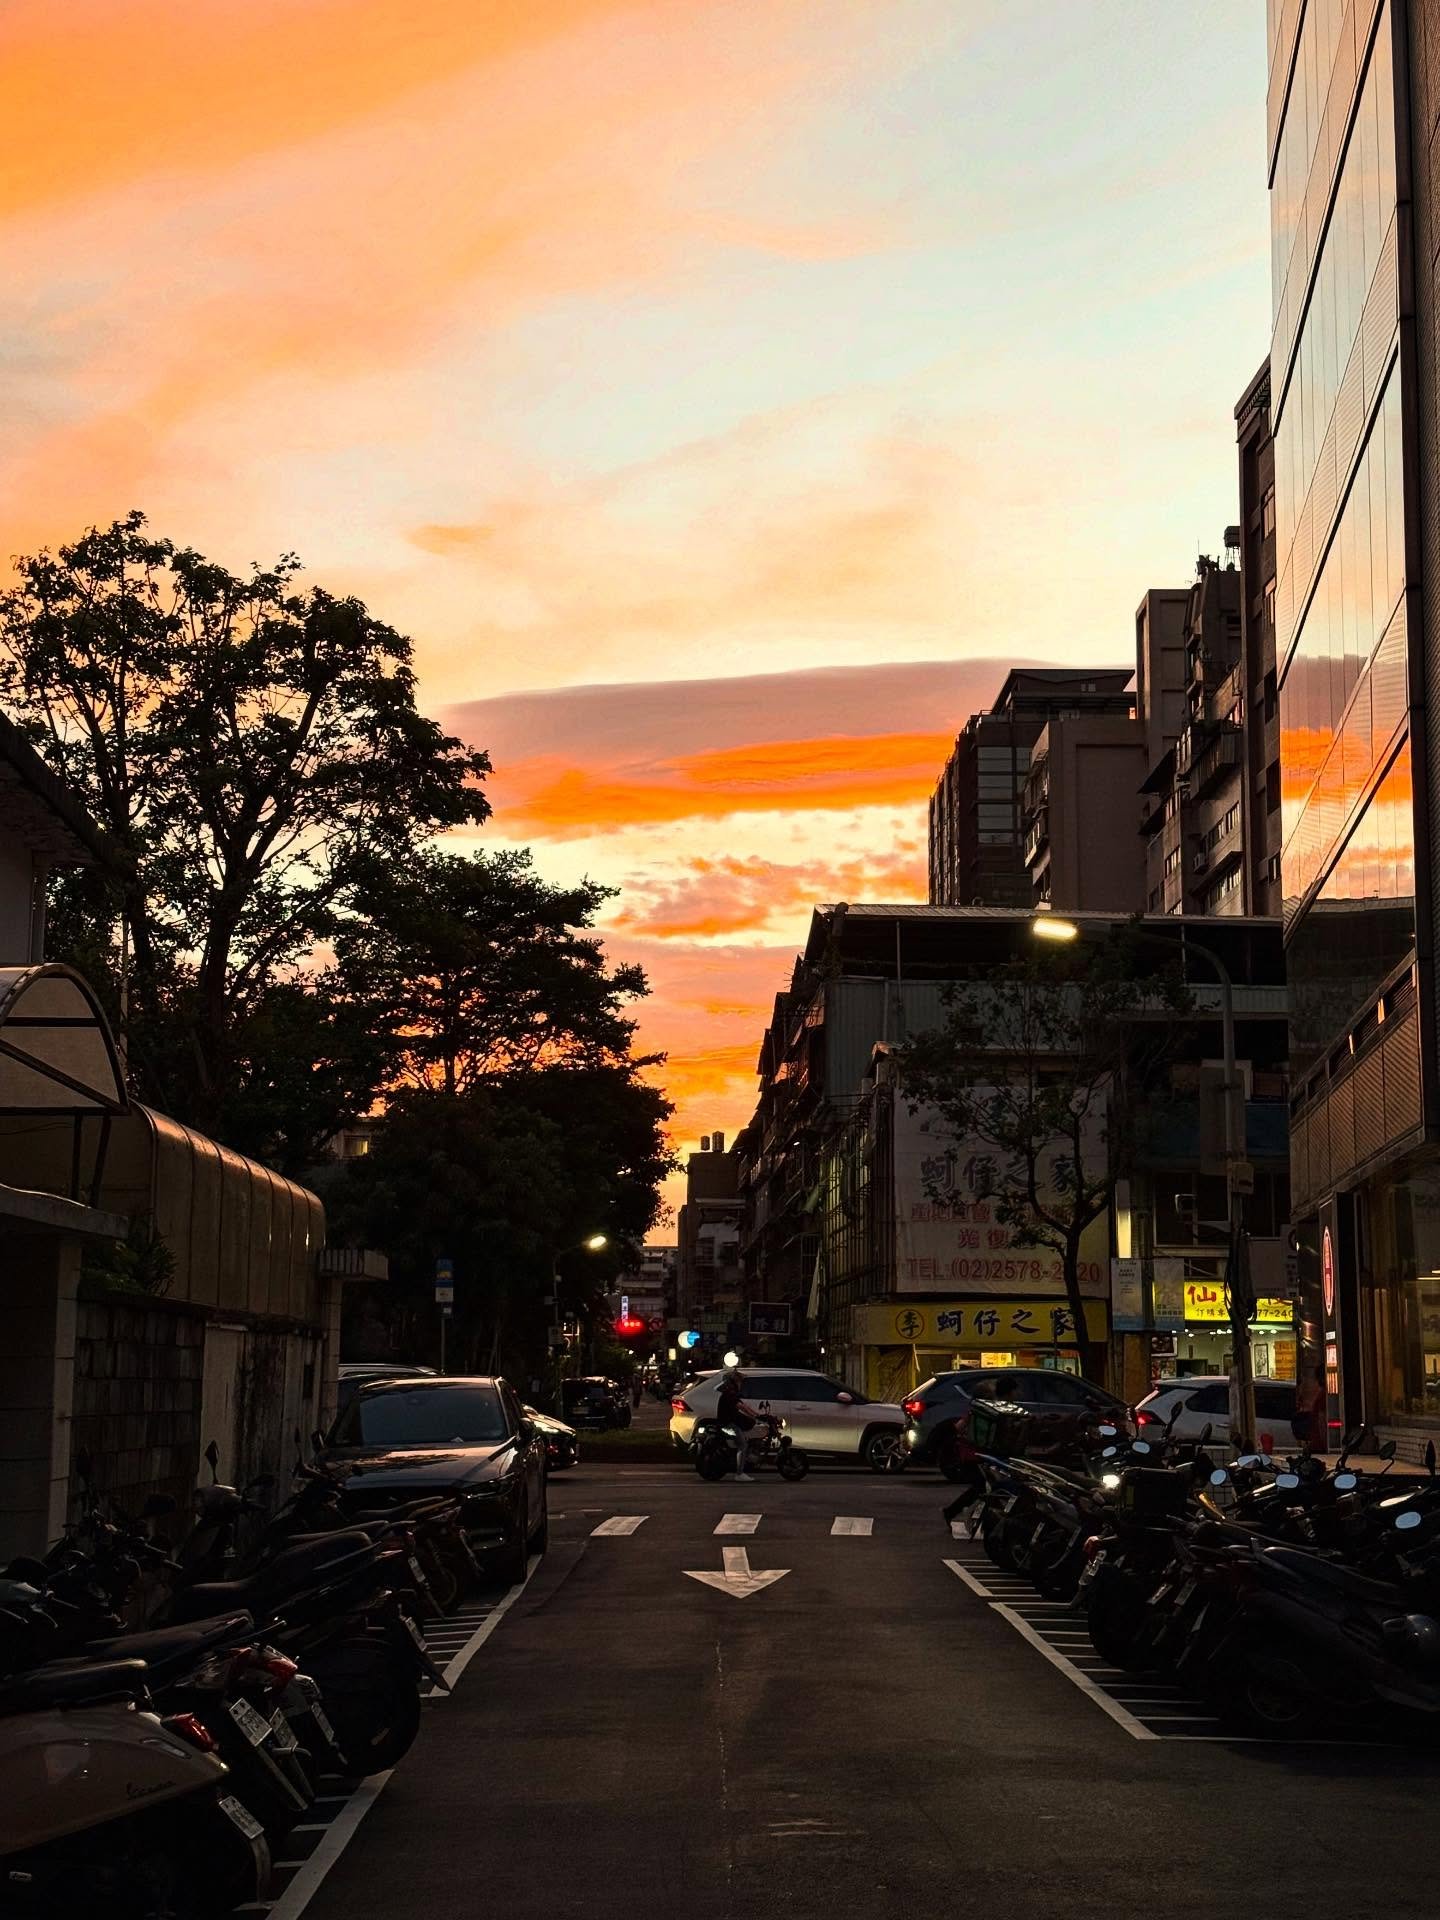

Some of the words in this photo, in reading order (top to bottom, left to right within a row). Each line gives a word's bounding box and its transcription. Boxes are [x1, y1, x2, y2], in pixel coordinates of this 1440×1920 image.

[951, 1258, 1100, 1282] (02)2578-220
[937, 1307, 1076, 1337] 蚵仔之家
